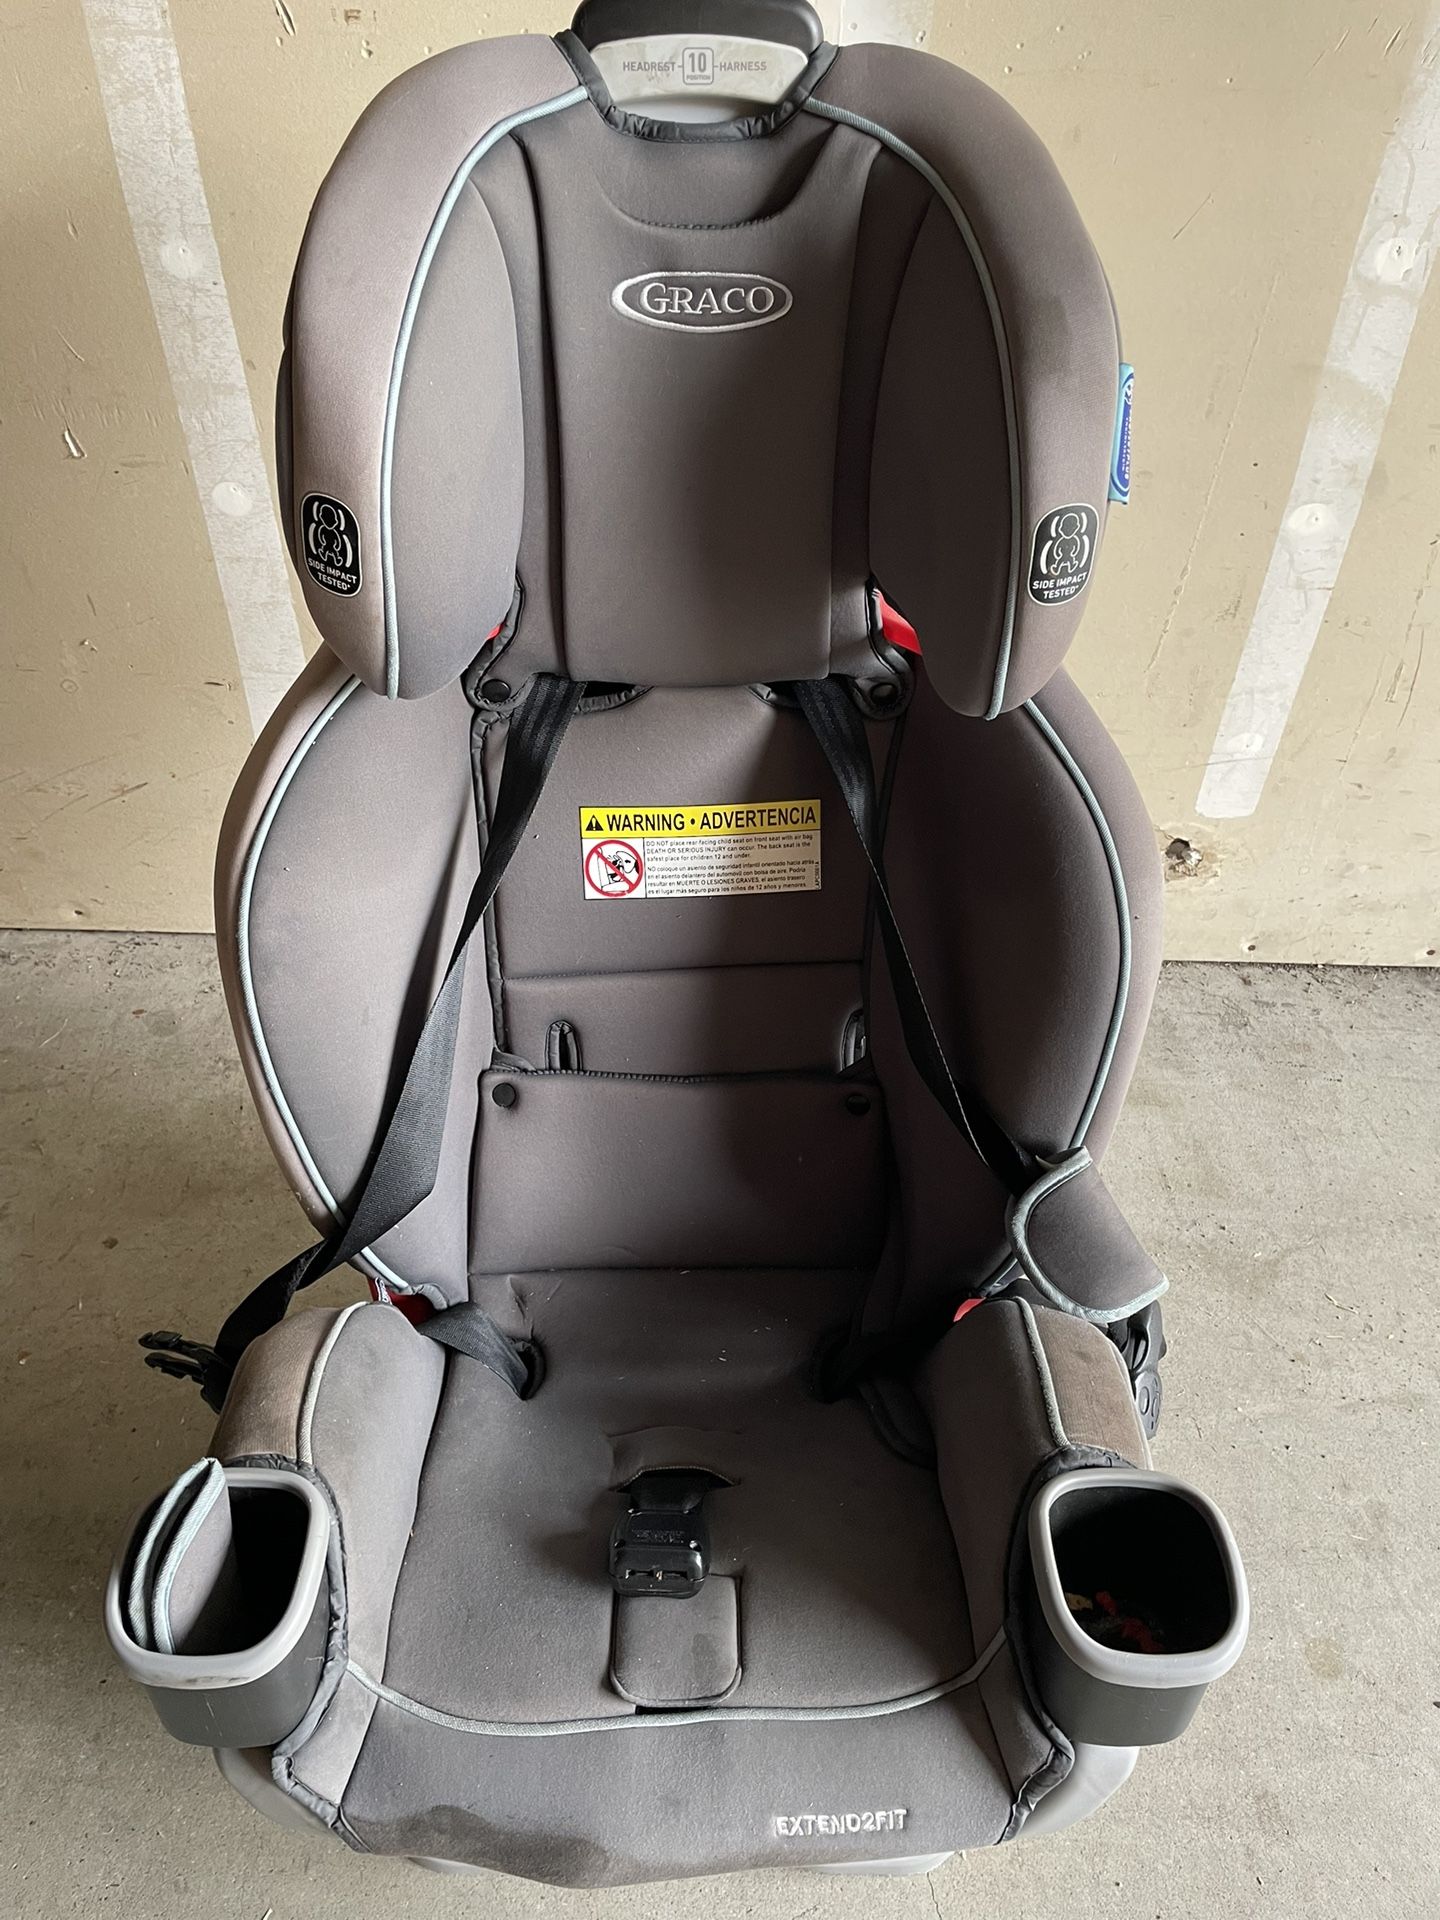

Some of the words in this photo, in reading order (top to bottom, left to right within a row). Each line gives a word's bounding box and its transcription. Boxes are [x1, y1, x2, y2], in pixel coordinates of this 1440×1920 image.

[622, 61, 676, 72] HEADREST
[688, 52, 707, 73] 10
[719, 61, 767, 72] HARNESS
[640, 282, 775, 314] GRACO
[308, 557, 326, 572] SIDE
[326, 566, 358, 584] IMPACT
[1032, 580, 1056, 590] SIDE
[1056, 571, 1088, 586] IMPACT
[606, 813, 685, 832] WARNING
[700, 806, 816, 830] ADVERTENCIA
[670, 840, 684, 848] place
[776, 1808, 907, 1836] EXTEND2FIT
